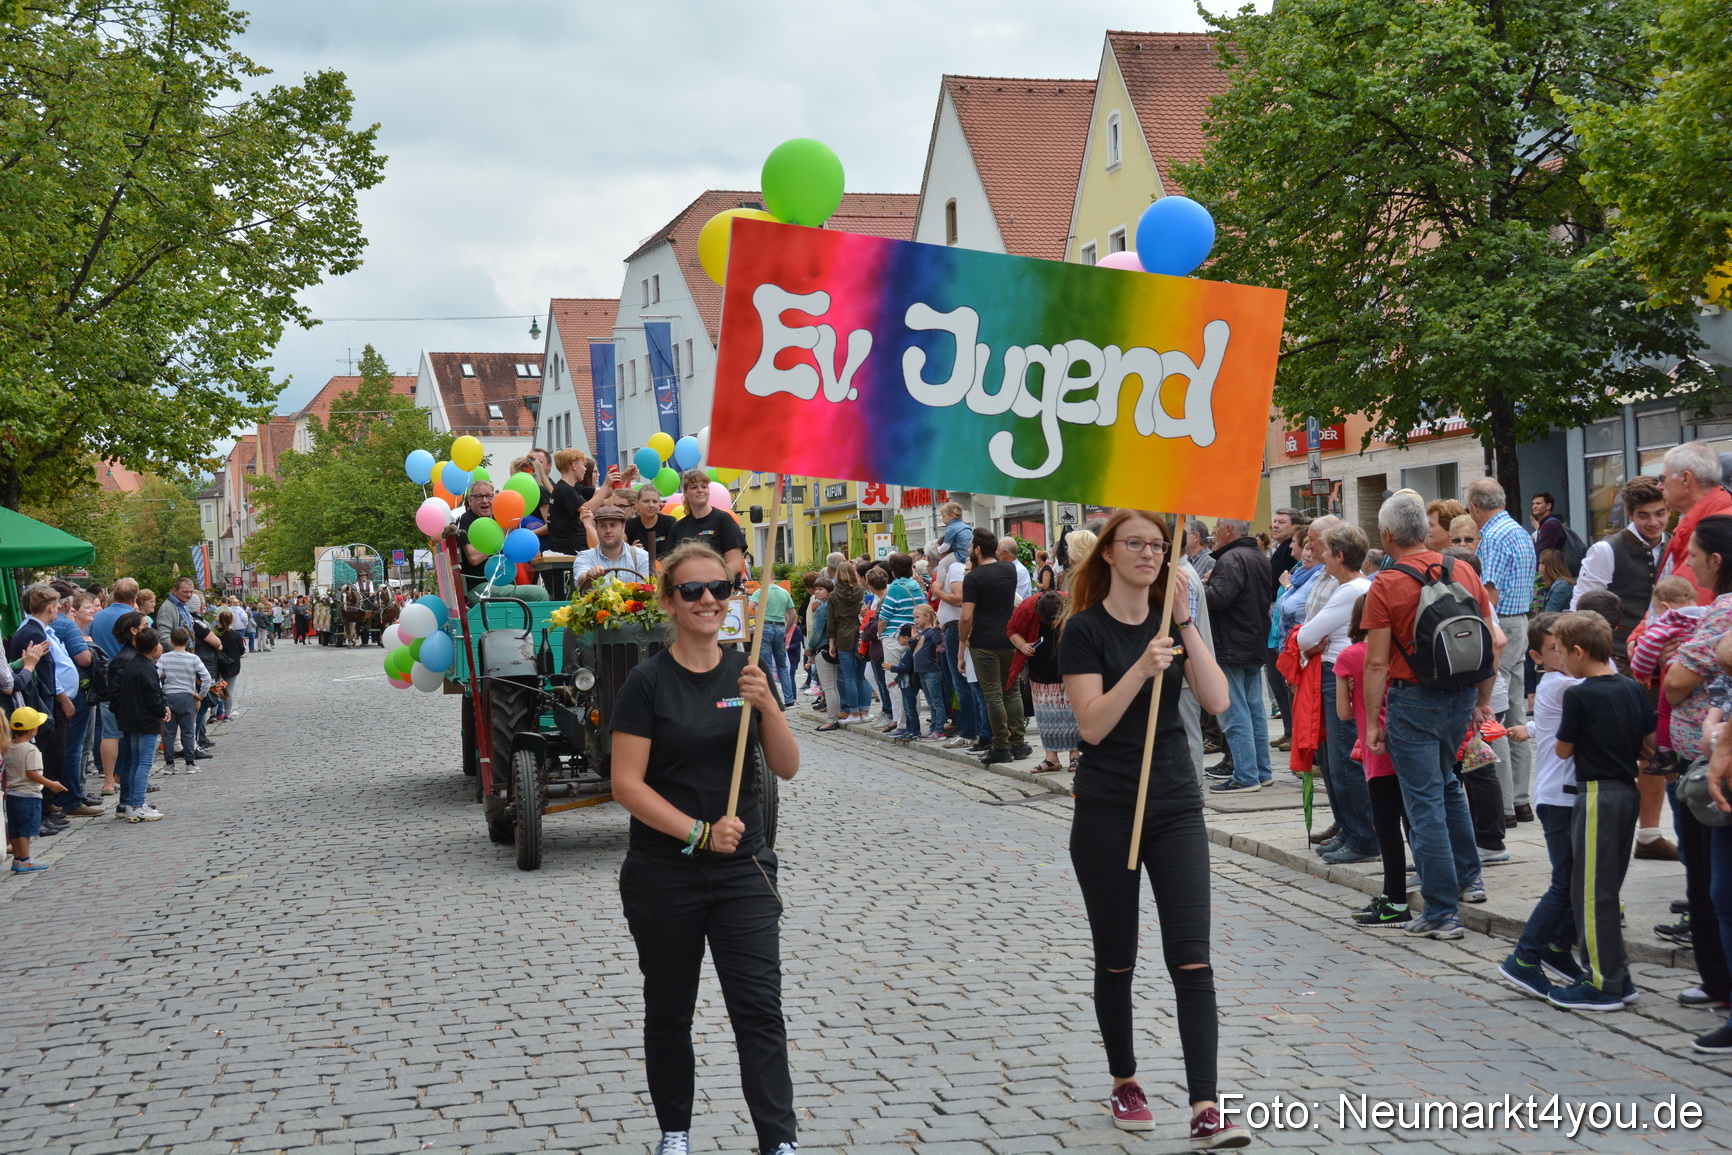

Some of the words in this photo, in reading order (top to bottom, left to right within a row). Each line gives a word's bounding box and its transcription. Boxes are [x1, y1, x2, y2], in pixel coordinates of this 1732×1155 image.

[658, 379, 674, 415] K&L
[744, 283, 873, 403] Ev.
[902, 301, 1230, 479] Jugend
